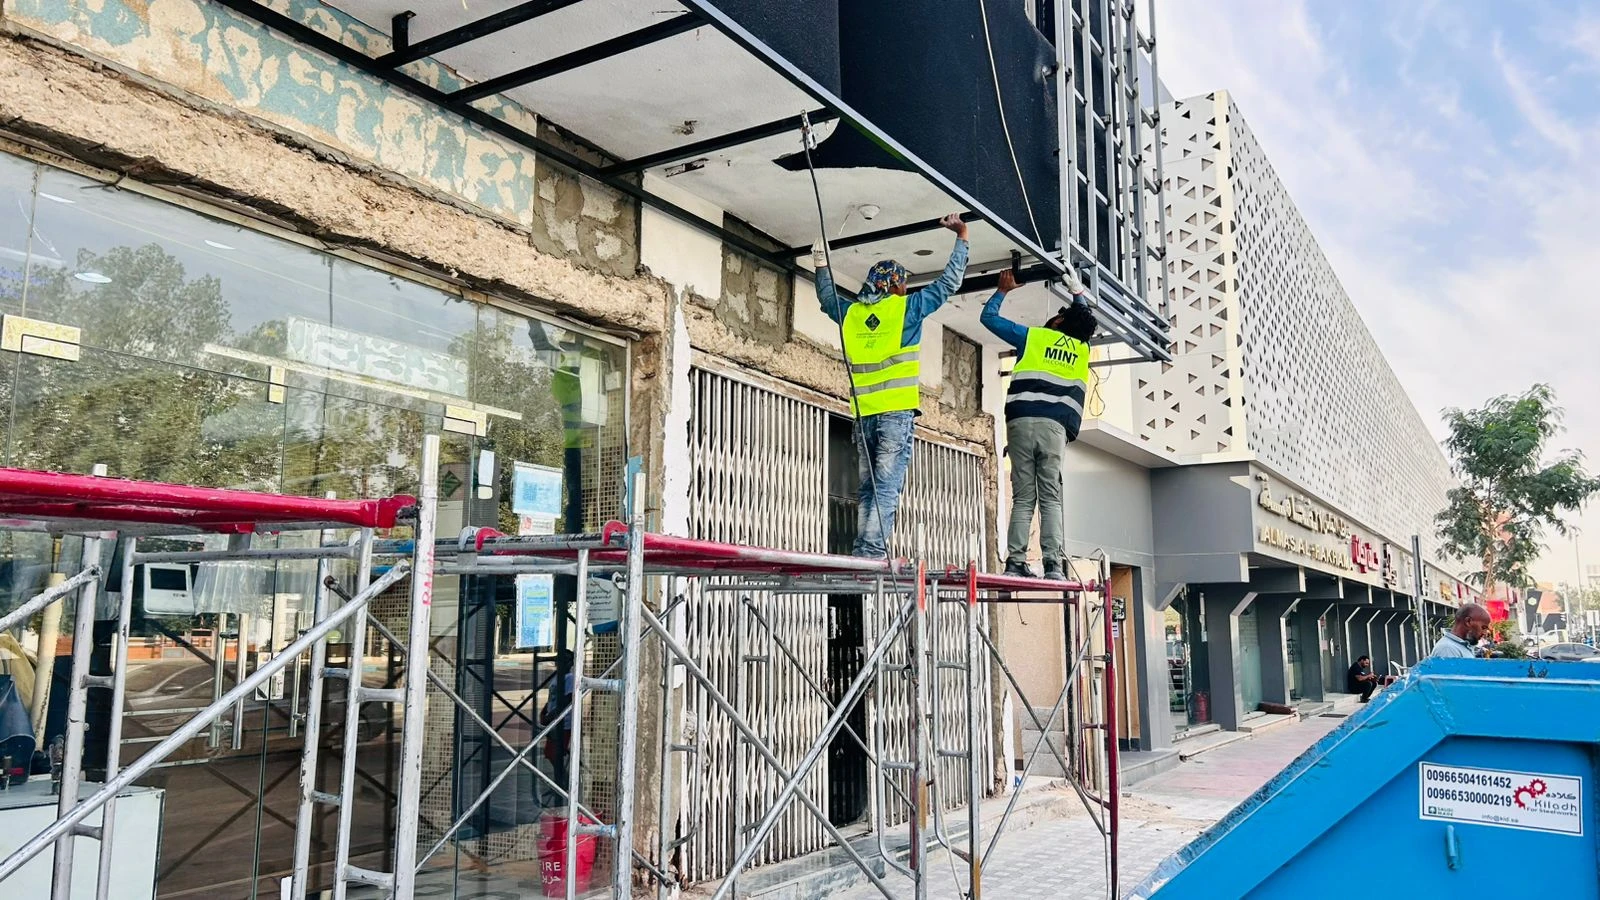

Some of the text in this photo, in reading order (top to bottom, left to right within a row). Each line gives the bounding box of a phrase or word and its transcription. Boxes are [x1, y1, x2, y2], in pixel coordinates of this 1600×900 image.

[1044, 346, 1079, 366] MINT
[1261, 525, 1296, 552] ALMAS
[1426, 769, 1512, 789] 00966504161452
[1426, 787, 1512, 807] 00966530000219
[1534, 799, 1578, 813] Kiladh
[538, 860, 562, 872] IRE
